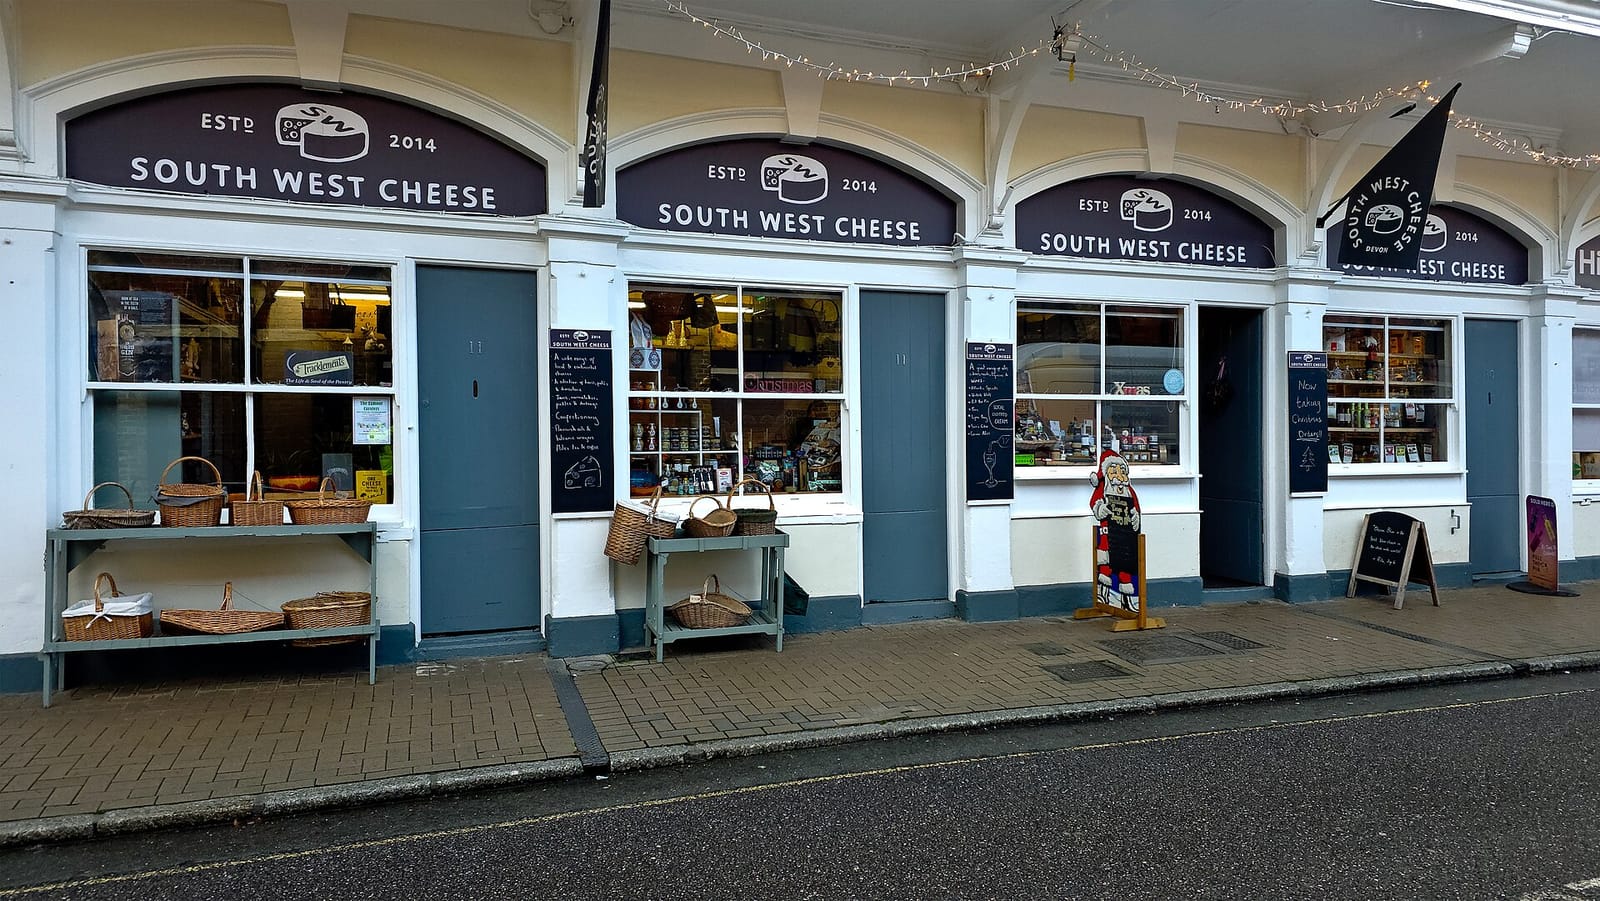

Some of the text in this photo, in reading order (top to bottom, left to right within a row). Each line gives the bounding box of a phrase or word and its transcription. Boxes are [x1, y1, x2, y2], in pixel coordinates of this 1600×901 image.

[201, 113, 437, 153] ESTD 2014
[130, 157, 497, 210] SOUTH WEST CHEESE
[708, 165, 878, 194] ESTD 2014
[1079, 199, 1213, 222] ESTD 2014
[1348, 176, 1423, 252] SOUTH WEST CHEESE
[658, 203, 921, 241] SOUTH WEST CHEESE
[1455, 231, 1479, 243] 2014
[1040, 232, 1247, 263] SOUTH WEST CHEESE
[1365, 245, 1389, 254] DEVON
[1406, 260, 1446, 276] EST
[1451, 261, 1506, 280] CHEESE
[300, 356, 345, 375] Tracklements
[744, 371, 813, 392] Christmas
[1112, 381, 1151, 395] Xmas
[1298, 380, 1317, 390] Now
[1296, 396, 1321, 413] taking
[1291, 414, 1322, 424] Christmas
